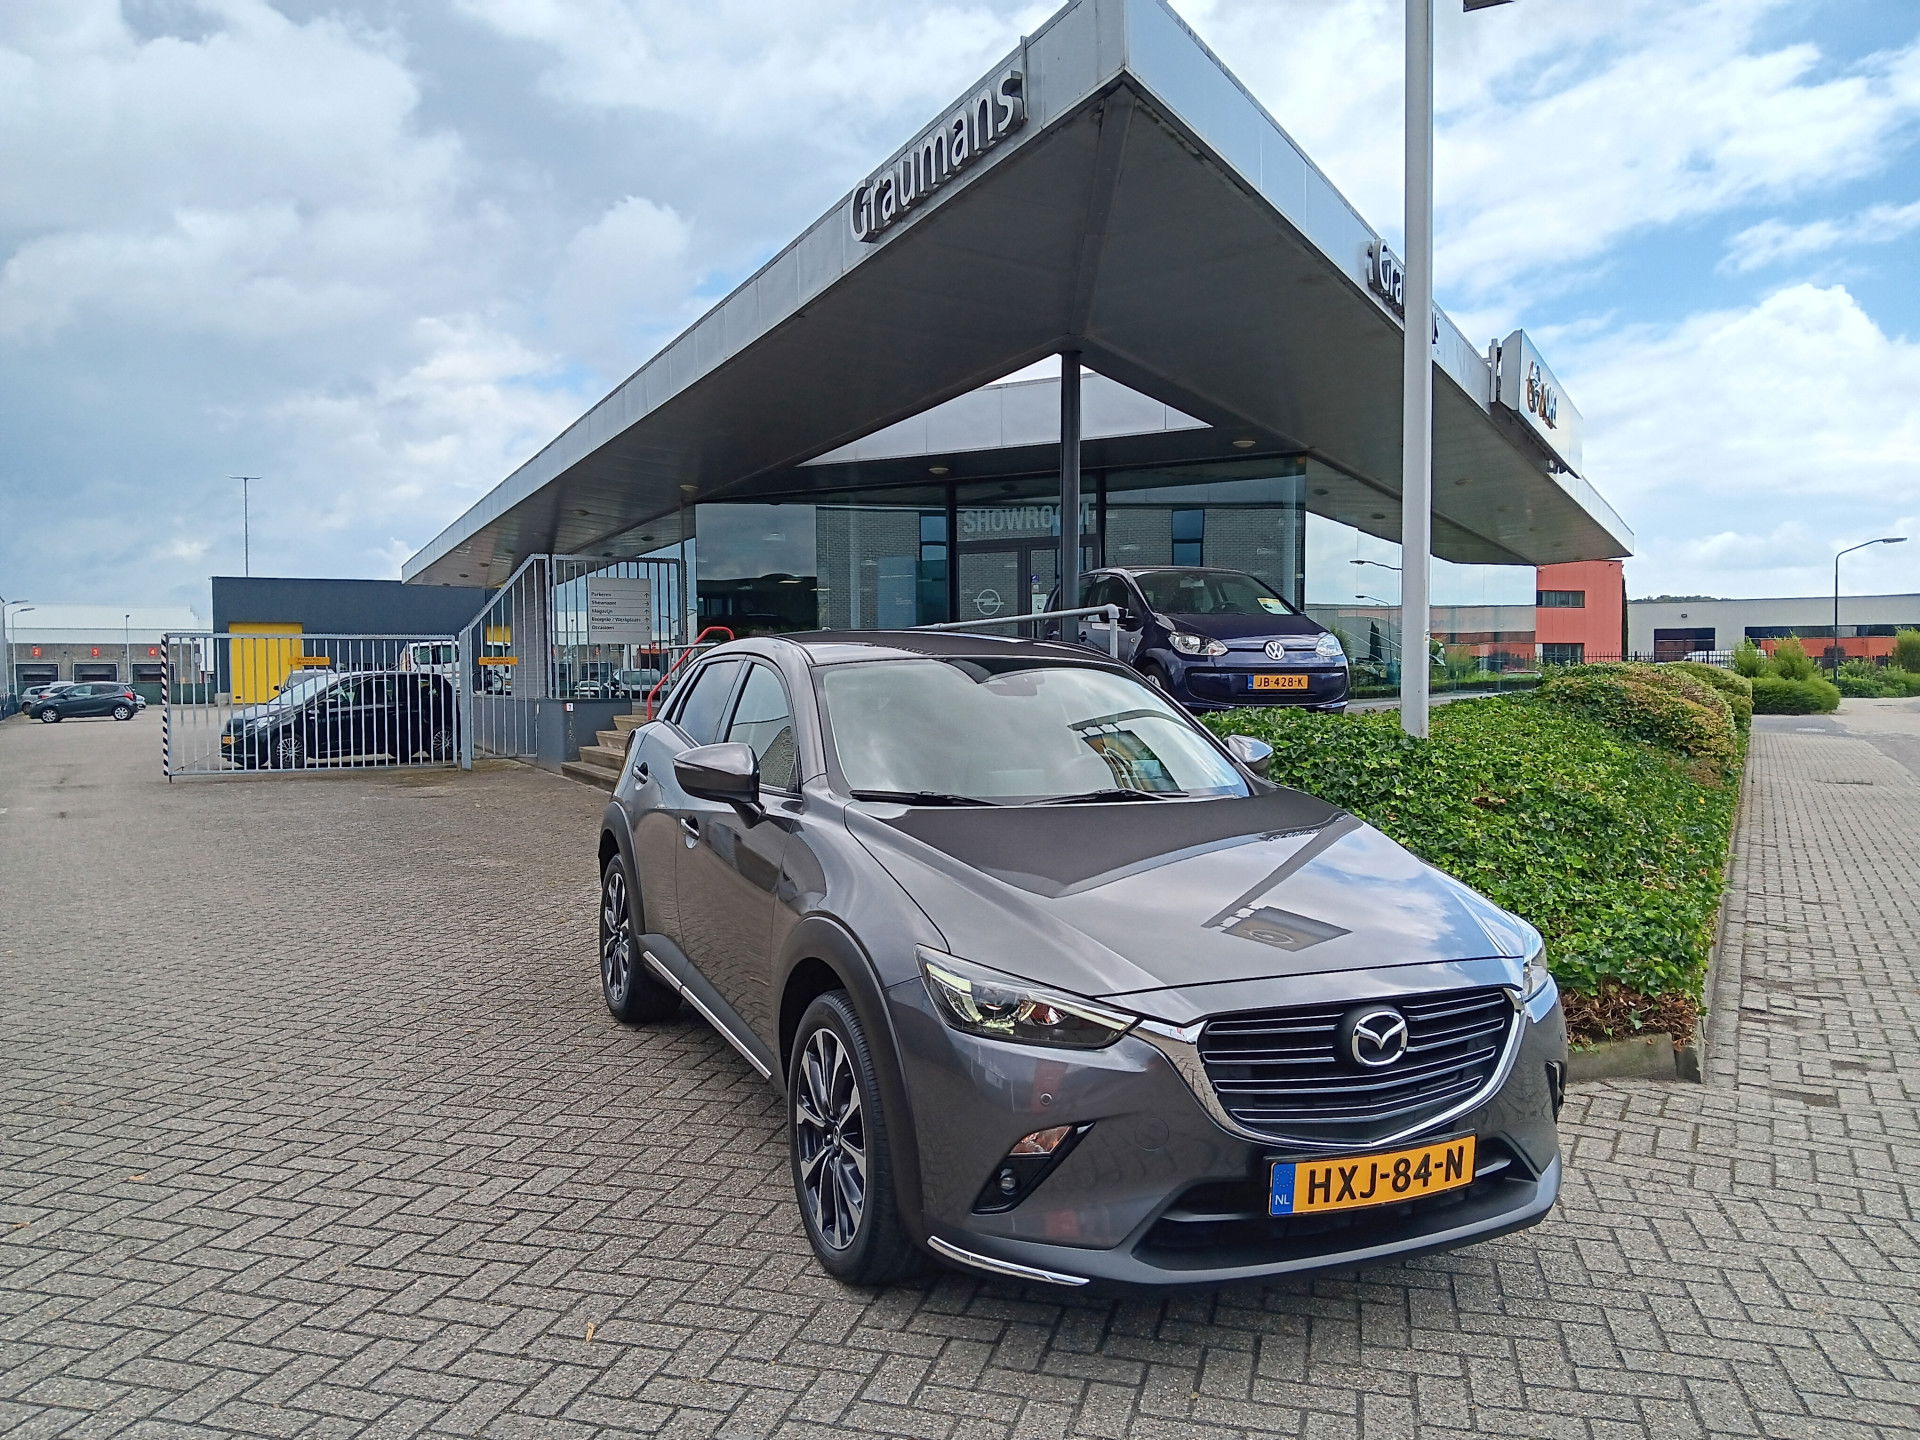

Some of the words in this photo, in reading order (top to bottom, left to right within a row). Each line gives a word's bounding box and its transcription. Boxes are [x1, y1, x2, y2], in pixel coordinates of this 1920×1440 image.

[850, 69, 1023, 242] Graumans
[1257, 678, 1304, 687] JB-428-K
[1307, 1145, 1465, 1205] HXJ-84-N
[1274, 1194, 1291, 1206] NL
